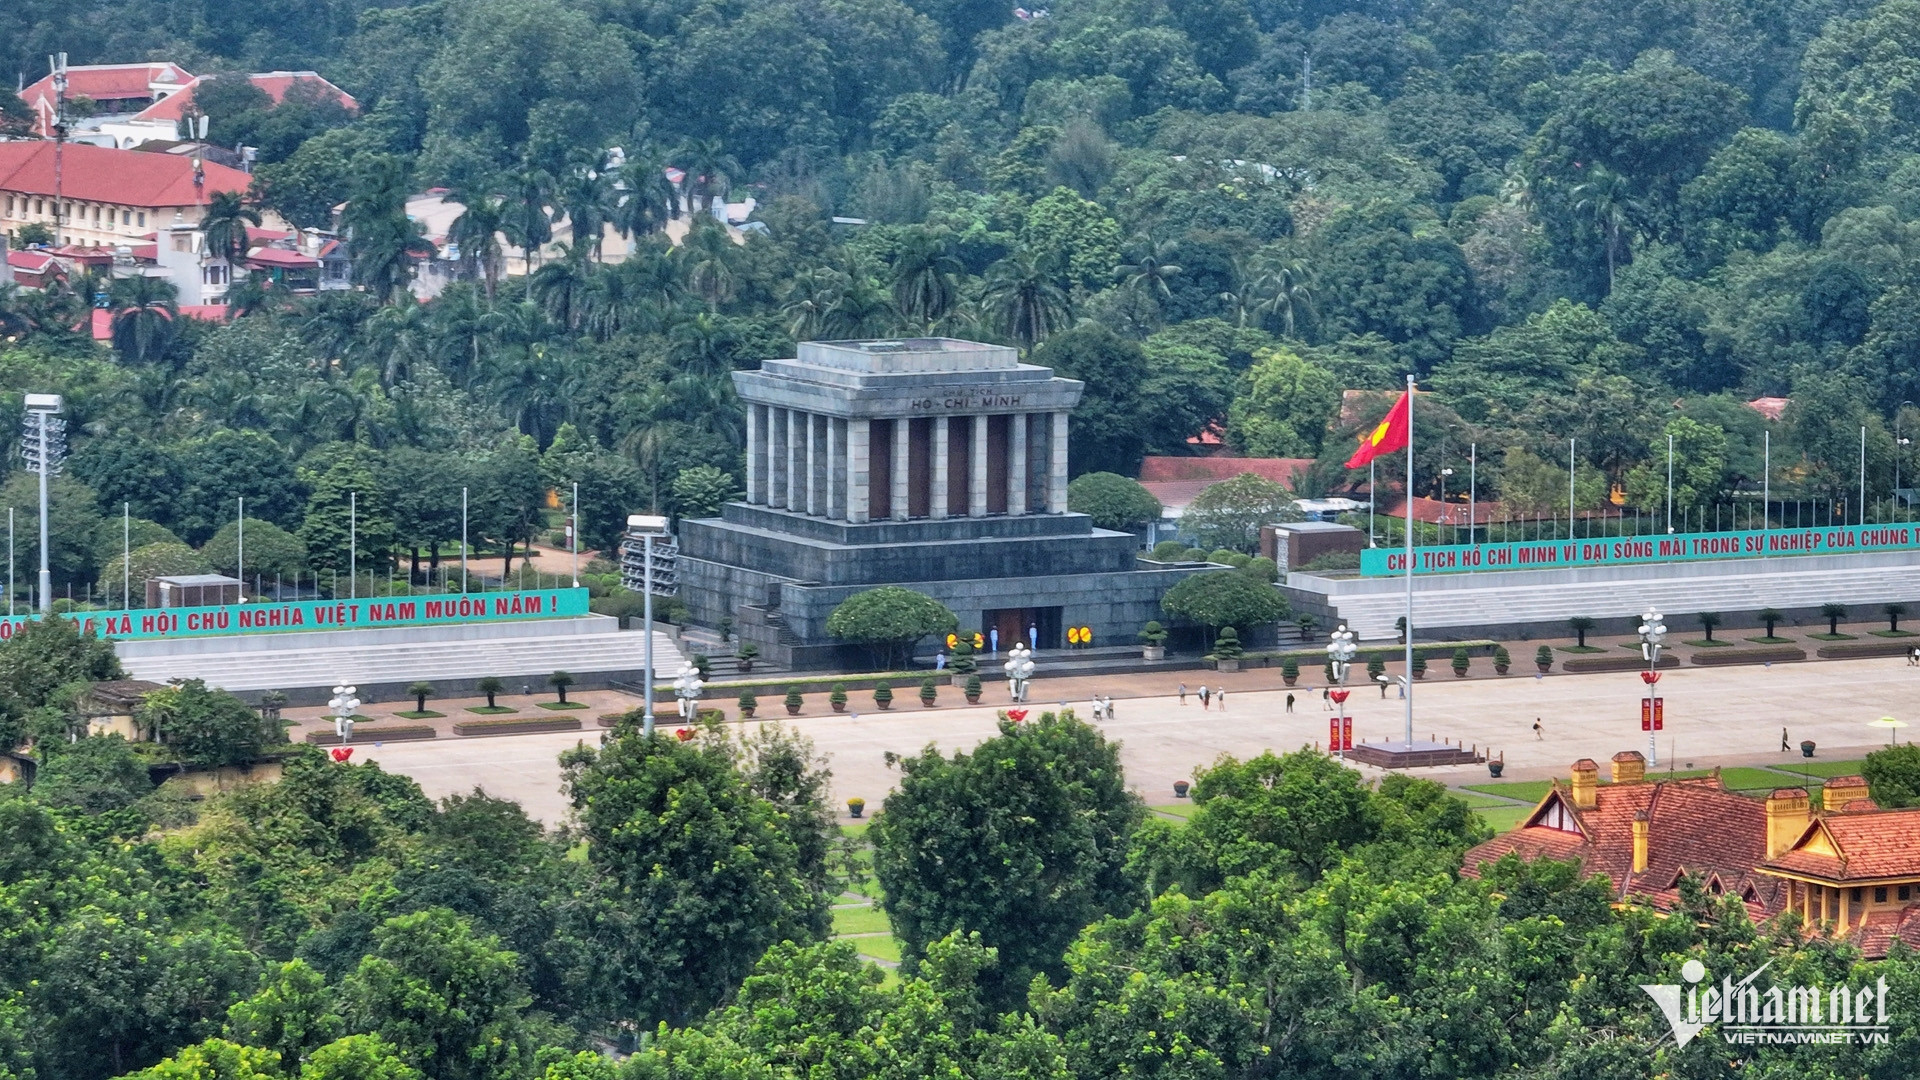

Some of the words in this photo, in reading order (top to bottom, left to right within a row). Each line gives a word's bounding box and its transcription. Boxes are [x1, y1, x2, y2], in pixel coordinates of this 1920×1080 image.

[1423, 551, 1456, 572] TỊCH
[1487, 544, 1512, 565] CHÍ
[1518, 546, 1557, 563] MINH
[1563, 541, 1577, 562] VĨ
[1583, 545, 1608, 563] ĐẠI
[1614, 536, 1653, 559] SỐNG
[1659, 537, 1686, 556] MÃI
[1693, 537, 1740, 555] TRONG
[1746, 534, 1765, 555] SỰ
[1770, 530, 1822, 552] NGHIỆP
[1827, 526, 1855, 548] CỦA
[1861, 526, 1909, 547] CHÚNG
[106, 613, 132, 635] XÃ
[142, 611, 177, 635] HỘI
[187, 607, 229, 631] CHỦ
[239, 605, 304, 628] NGHĨA
[315, 602, 360, 626] VIỆT
[369, 602, 416, 622] NAM
[425, 596, 487, 619] MUÔN
[496, 594, 542, 616] NĂM
[551, 595, 557, 613] !
